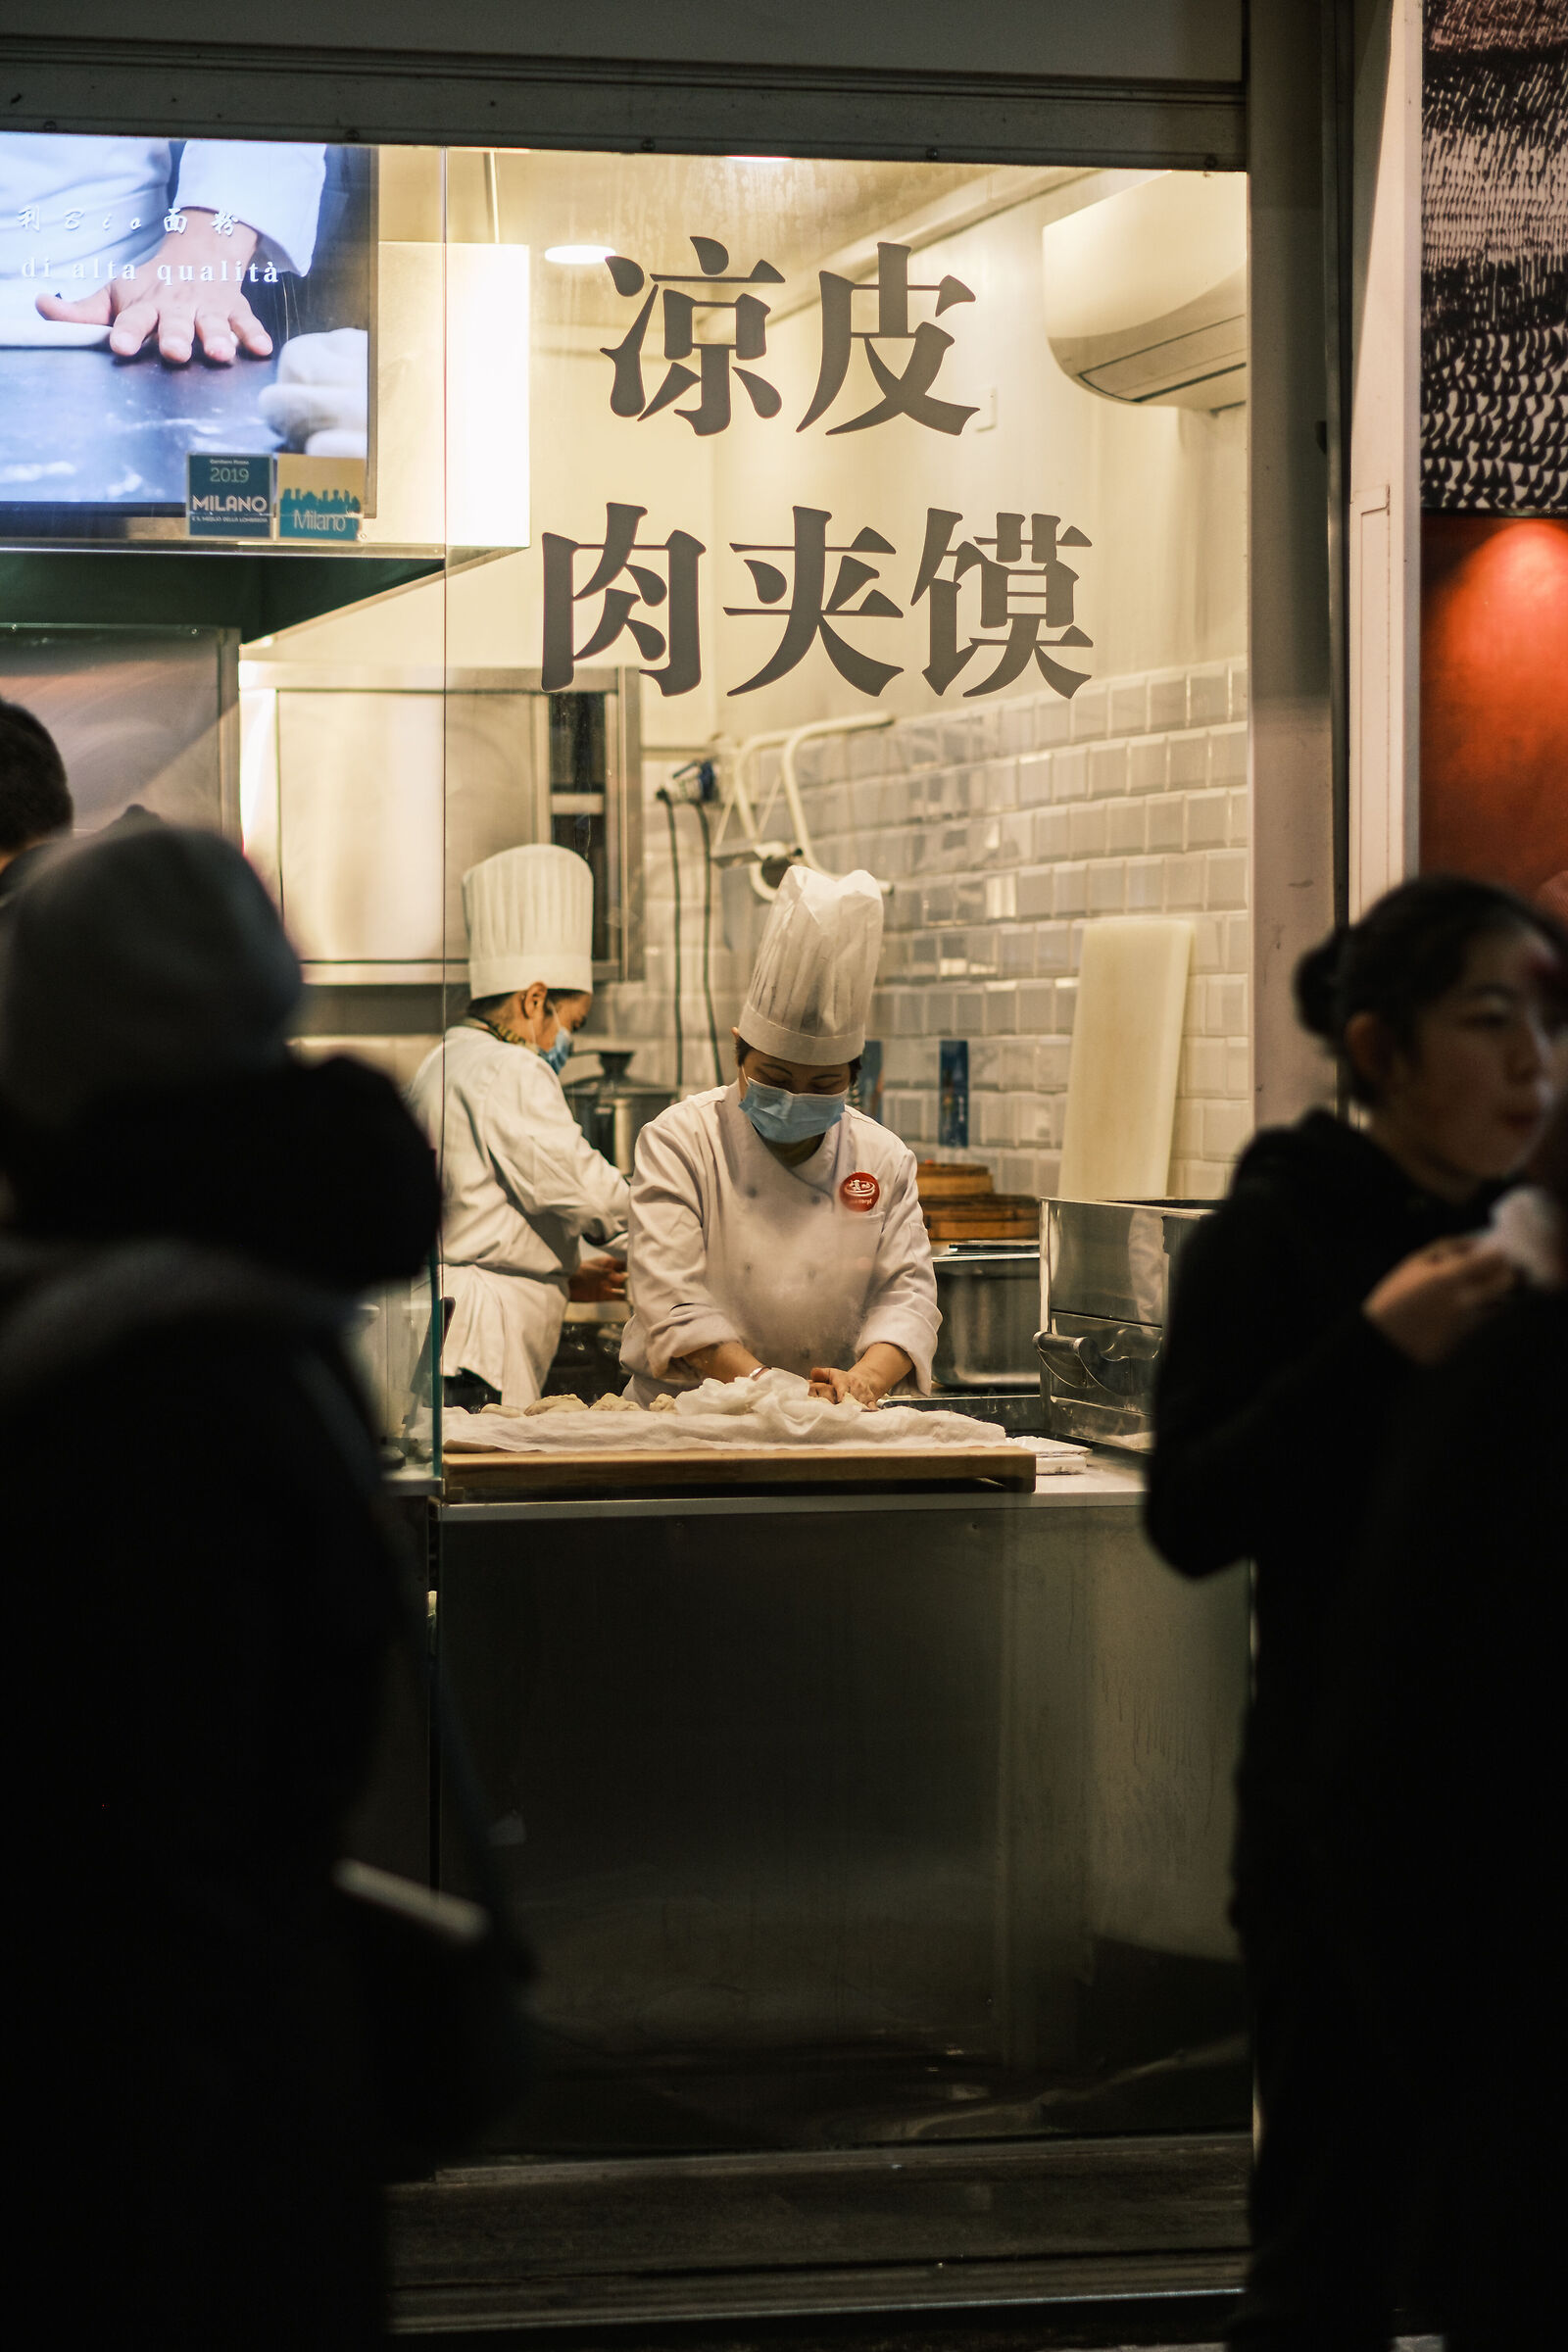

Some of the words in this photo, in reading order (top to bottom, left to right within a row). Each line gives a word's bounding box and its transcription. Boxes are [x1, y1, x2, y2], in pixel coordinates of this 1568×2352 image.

[21, 258, 52, 278] di
[73, 260, 137, 280] alta
[157, 260, 279, 286] qualità
[599, 235, 981, 437] 凉皮
[210, 466, 250, 483] 2019
[192, 495, 268, 513] MILANO
[294, 508, 346, 532] Milano
[540, 501, 1095, 700] 肉夹馍
